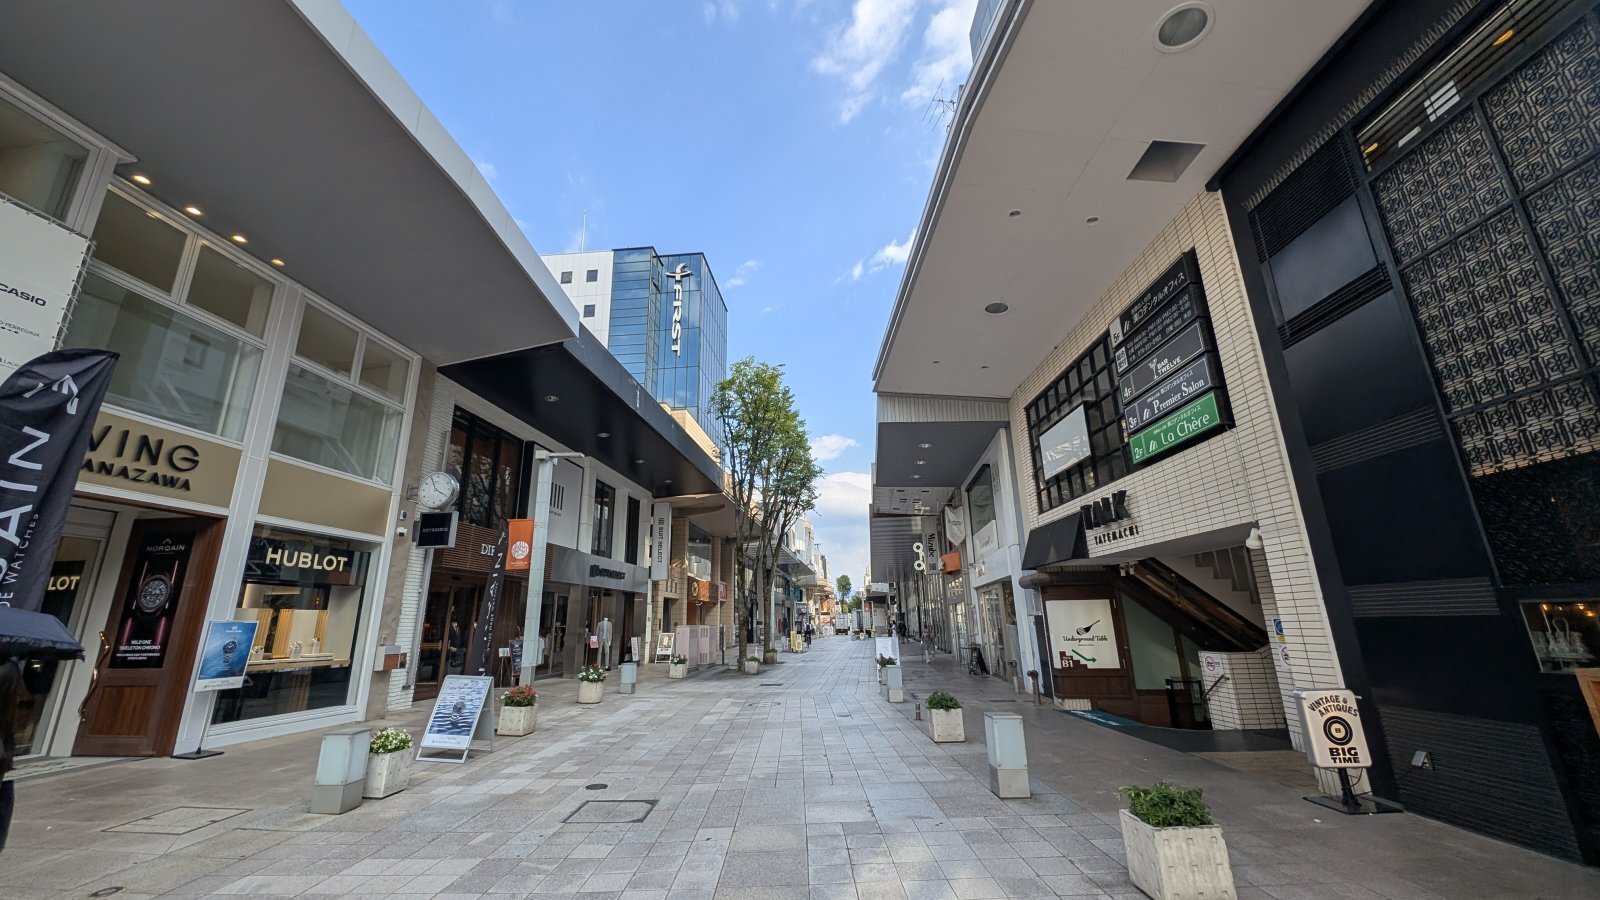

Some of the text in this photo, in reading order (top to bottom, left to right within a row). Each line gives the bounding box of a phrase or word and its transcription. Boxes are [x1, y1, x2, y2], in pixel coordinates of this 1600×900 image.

[0, 283, 47, 307] CASIO
[1113, 332, 1121, 343] 5F
[1157, 358, 1168, 369] BAR
[1158, 355, 1181, 375] TWELVE
[1124, 388, 1132, 398] 4F
[1153, 379, 1205, 414] Premier Salon
[1129, 417, 1137, 429] 3F
[1161, 414, 1210, 445] La Chère
[88, 425, 200, 472] VING
[1134, 447, 1143, 459] 2F
[81, 458, 191, 491] ANAZAWA
[1094, 525, 1139, 545] TATEMACHI
[146, 544, 185, 552] NORQAIN
[265, 548, 348, 572] HUBLOT
[47, 575, 81, 591] LOT
[1062, 635, 1095, 643] Underground
[1062, 660, 1073, 668] B1
[1307, 695, 1340, 712] VINTAGE
[1318, 704, 1359, 717] ANTIQUES
[1328, 747, 1358, 757] BIG
